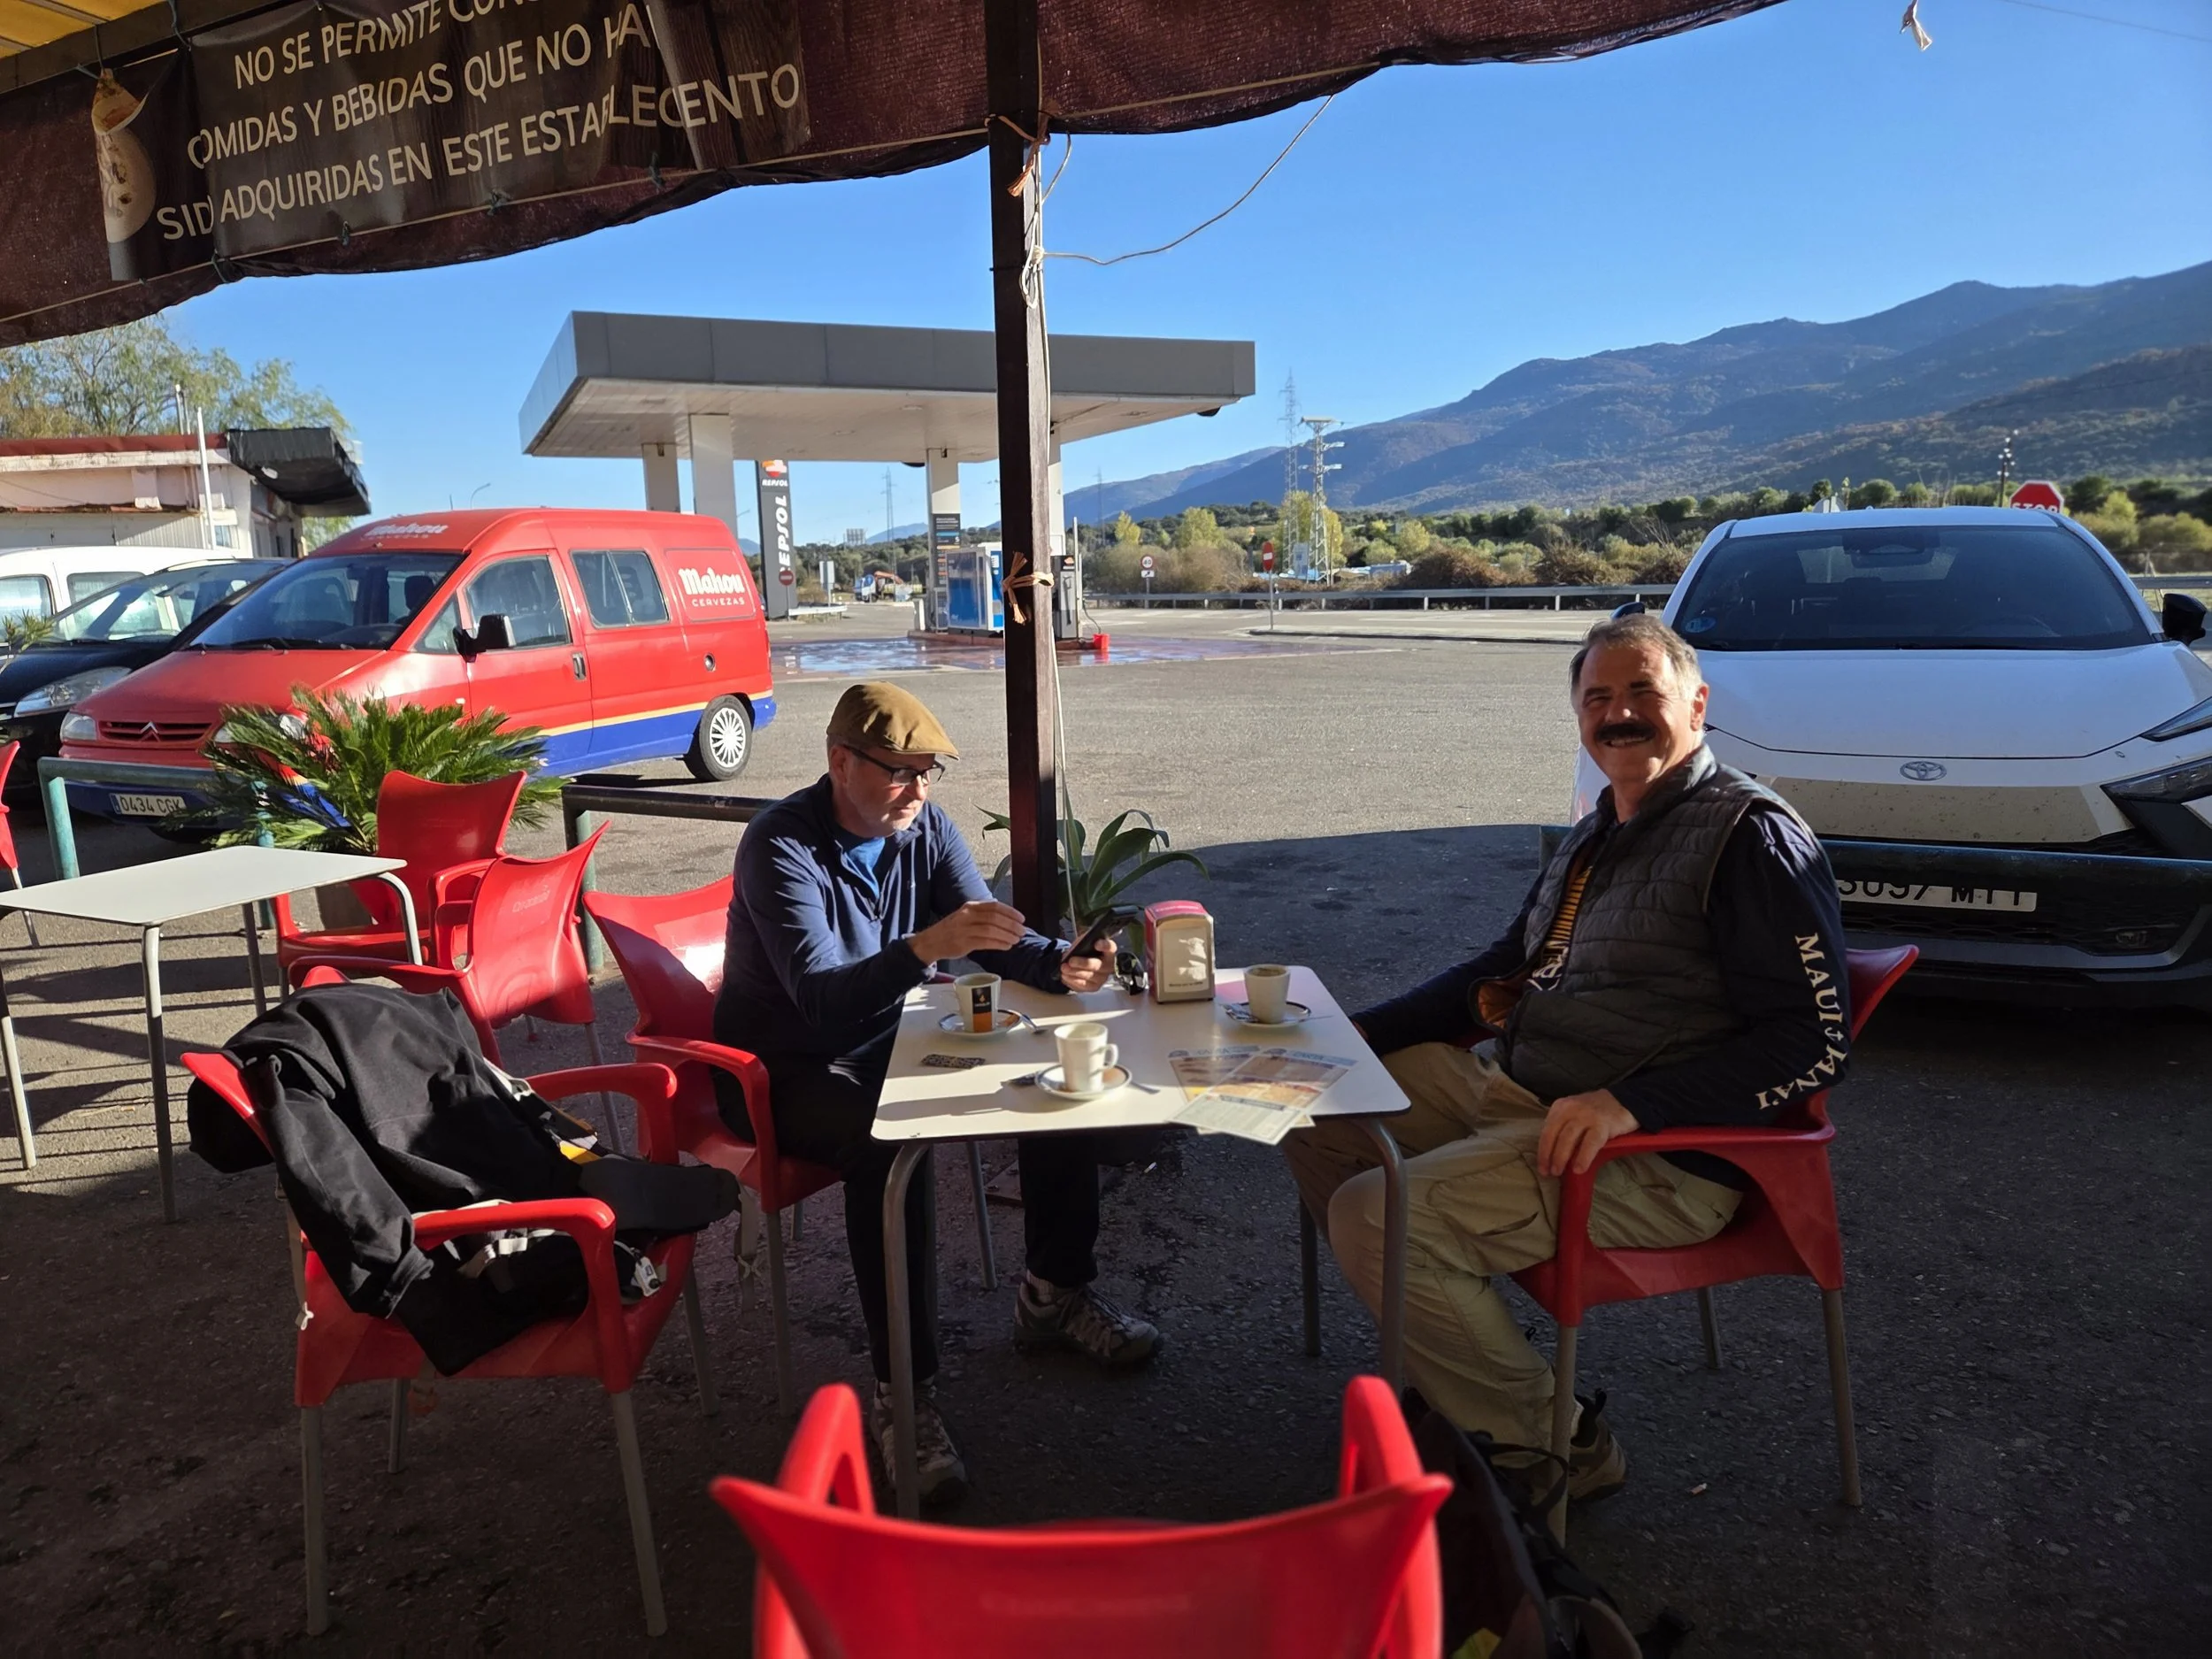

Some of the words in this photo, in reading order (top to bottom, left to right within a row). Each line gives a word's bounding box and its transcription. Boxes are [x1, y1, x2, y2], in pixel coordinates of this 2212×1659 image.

[234, 46, 275, 89] NO
[281, 32, 314, 74] SE
[321, 0, 442, 64] PERMITE
[303, 98, 323, 136] Y
[332, 63, 454, 131] BEBIDAS
[464, 40, 527, 104] QUE
[536, 23, 592, 75] NO
[220, 154, 383, 223] ADQUIRIDAS
[388, 142, 433, 186] EN
[442, 122, 513, 176] ESTE
[775, 495, 791, 572] EPSOL
[678, 567, 745, 595] Mahou
[692, 596, 745, 608] CERVEZAS
[119, 796, 155, 813] 0434
[1794, 933, 1843, 1023] MAUI
